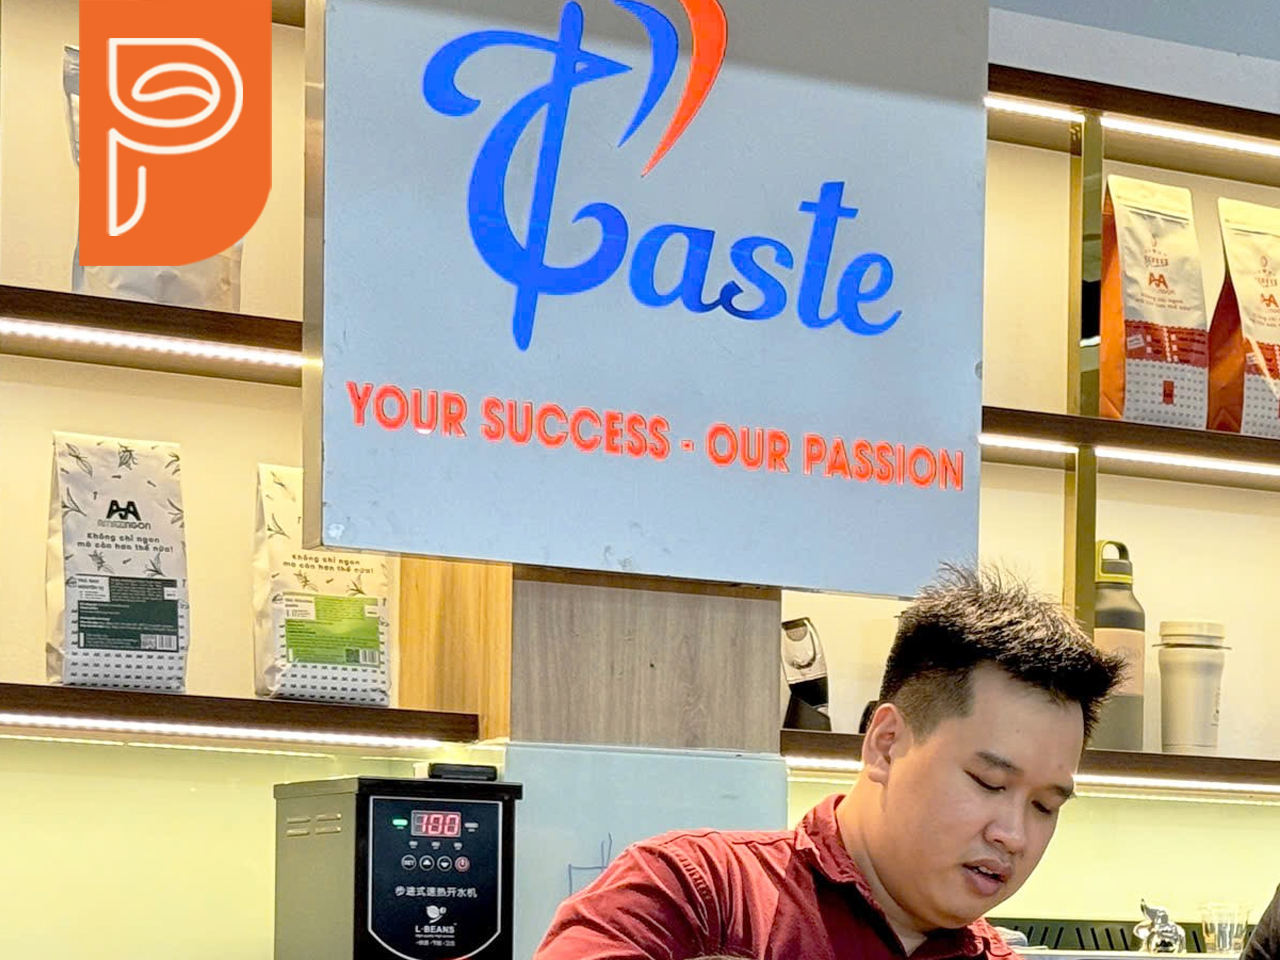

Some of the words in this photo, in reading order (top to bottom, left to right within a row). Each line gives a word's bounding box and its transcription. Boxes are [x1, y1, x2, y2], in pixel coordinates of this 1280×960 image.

[346, 381, 467, 437] YOUR
[480, 397, 671, 460] SUCCESS
[705, 423, 790, 472] OUR
[803, 434, 964, 491] PASSION
